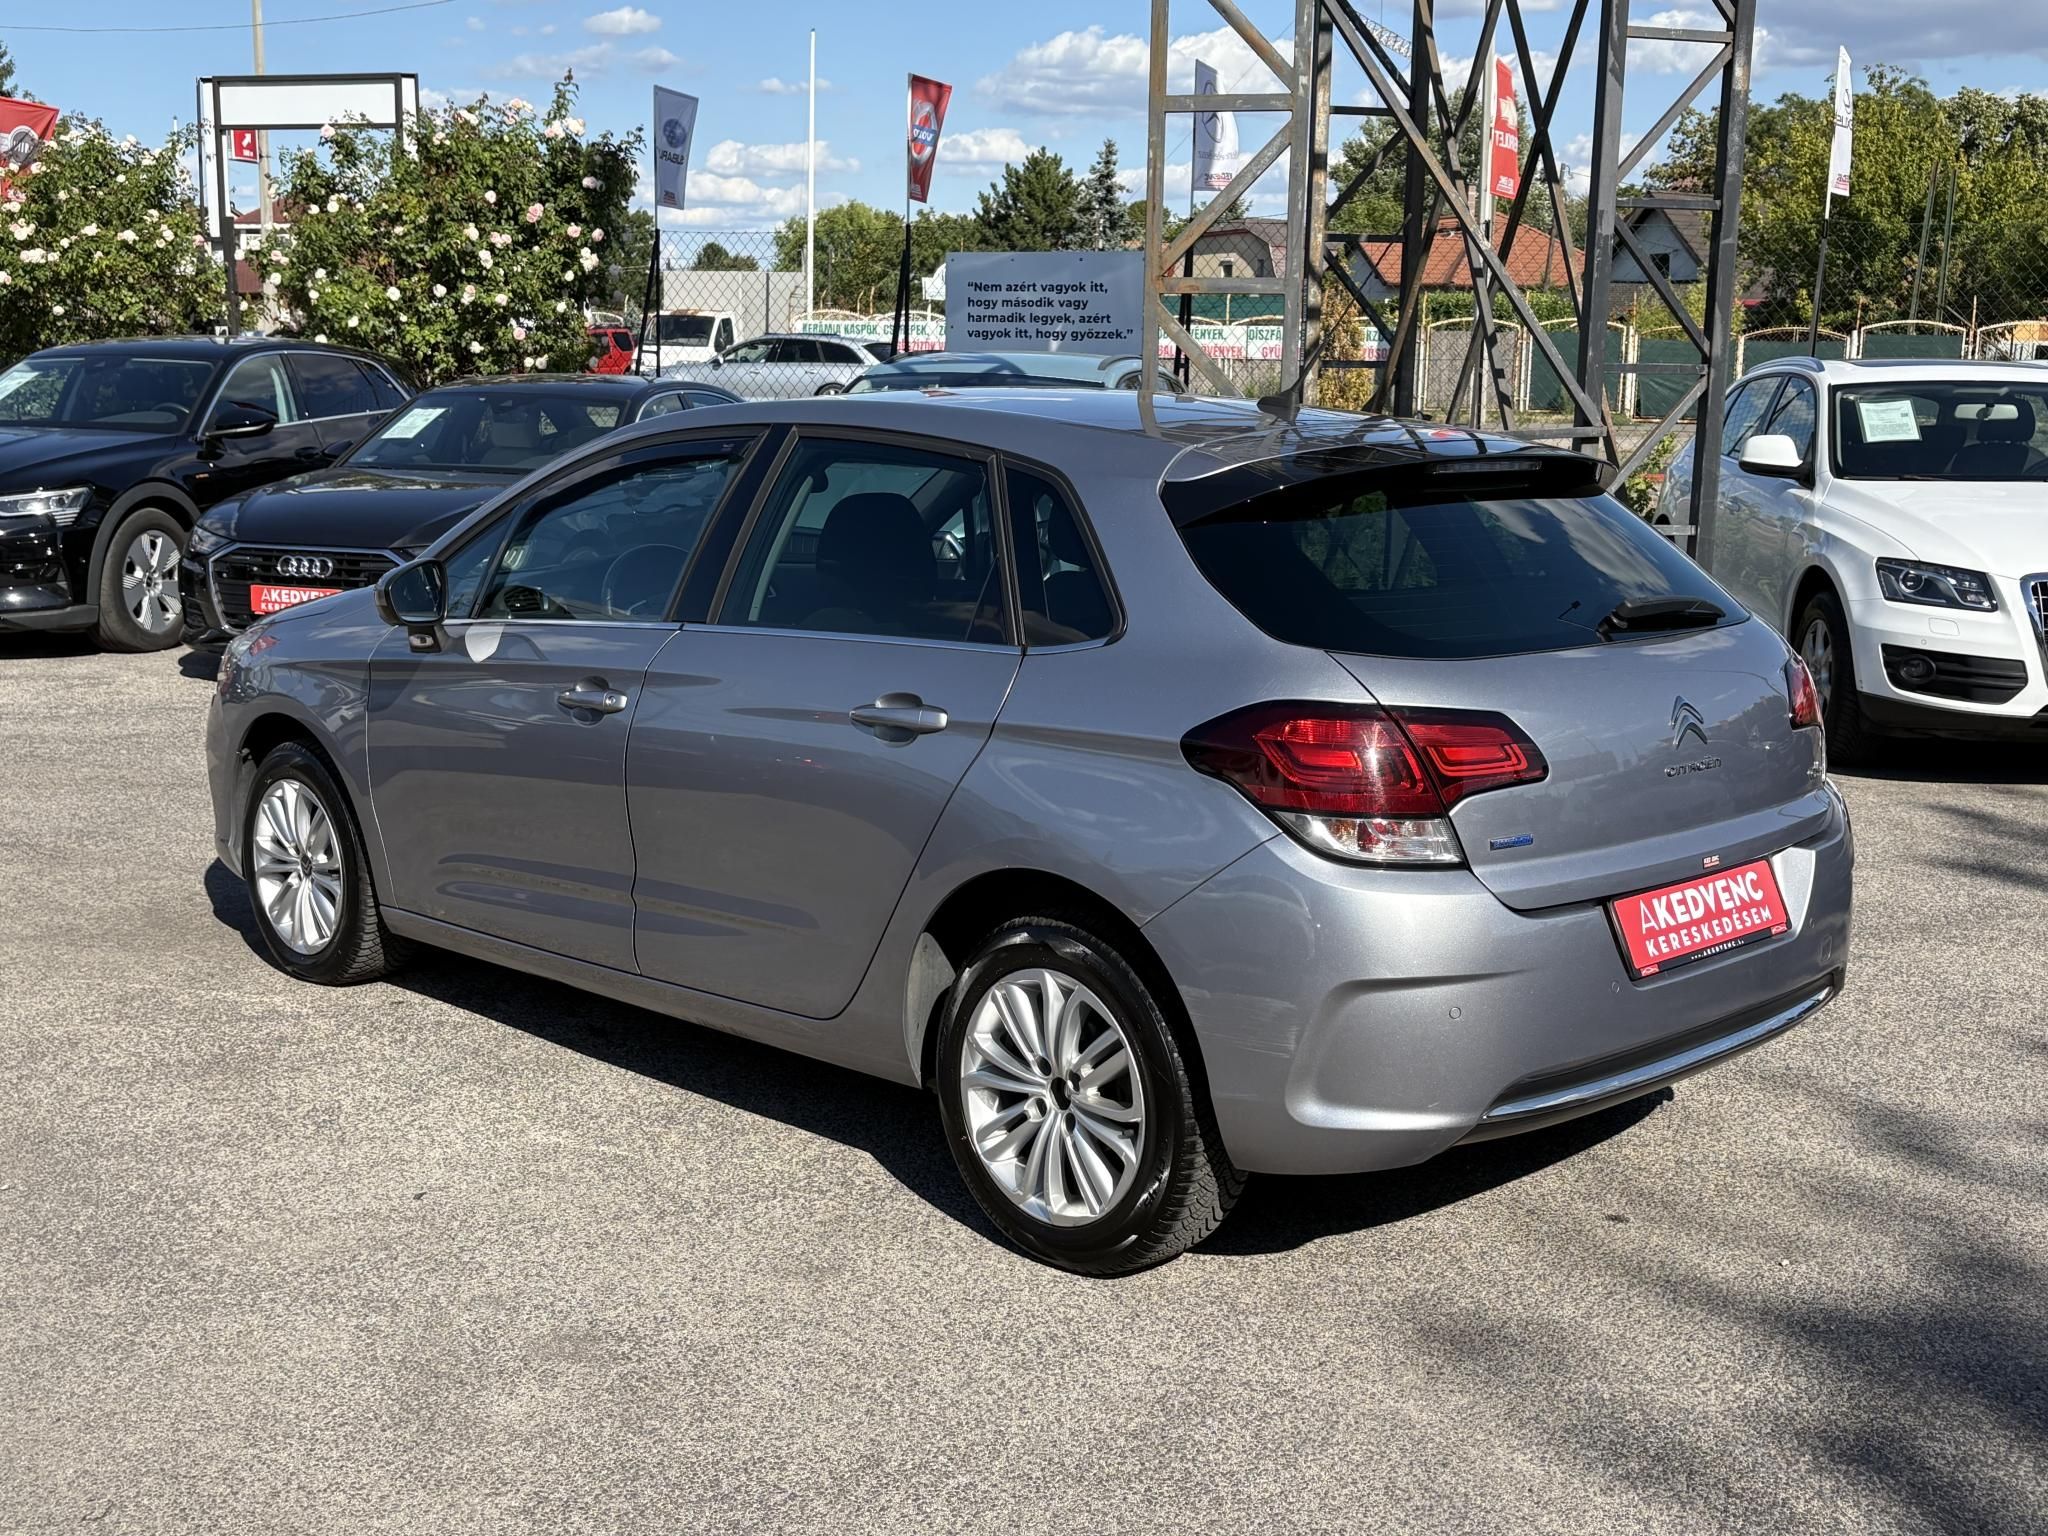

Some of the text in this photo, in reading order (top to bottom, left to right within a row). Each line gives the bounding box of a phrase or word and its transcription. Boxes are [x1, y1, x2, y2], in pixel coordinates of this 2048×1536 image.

[967, 281, 1108, 294] “Nem azért vagyok itt,
[967, 297, 1088, 310] hogy második vagy
[967, 313, 1111, 326] harmadik legyek, azért
[967, 328, 1011, 340] vagyok
[1015, 328, 1032, 340] itt,
[1035, 328, 1067, 341] hogy
[1248, 327, 1281, 340] DÍSZFÁ
[1645, 904, 1772, 957] KERESKEDÉSEM
